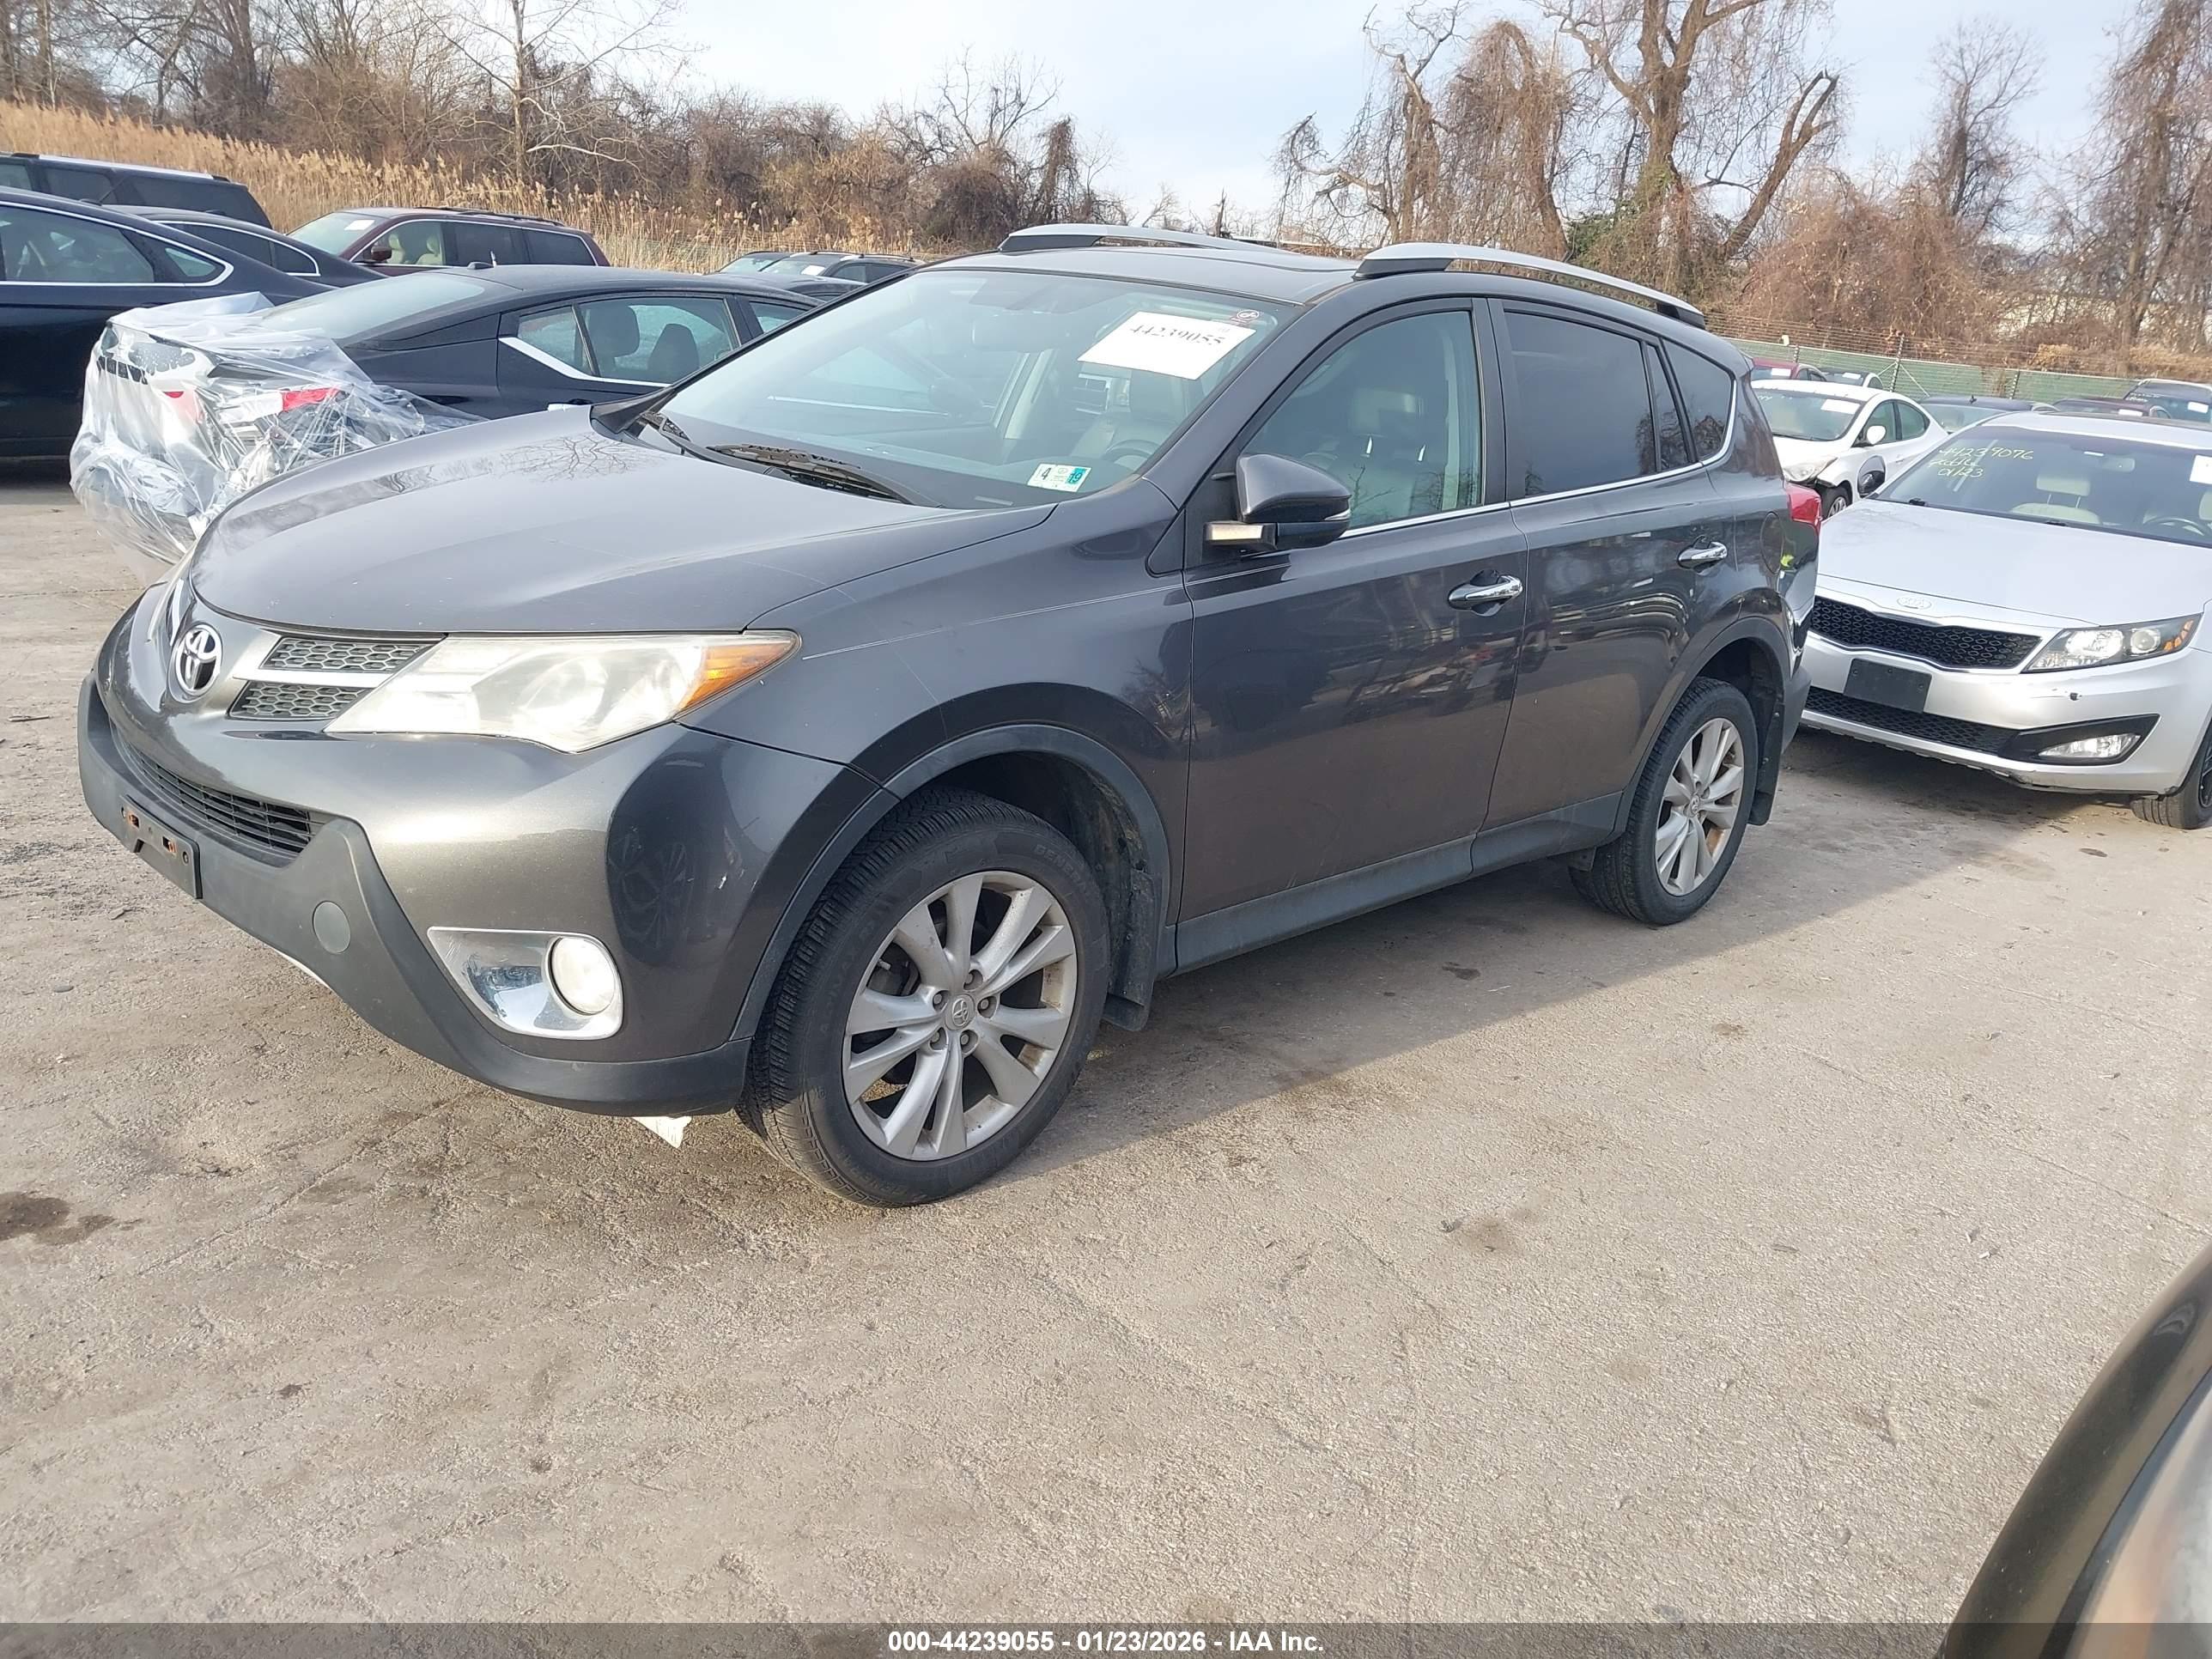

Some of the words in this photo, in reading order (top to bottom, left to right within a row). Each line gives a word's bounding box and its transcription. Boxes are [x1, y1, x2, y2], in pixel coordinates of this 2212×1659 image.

[1130, 324, 1227, 346] 44239055
[1938, 446, 2034, 460] 44239076
[1041, 466, 1053, 481] 4
[1937, 466, 1984, 478] 01/23
